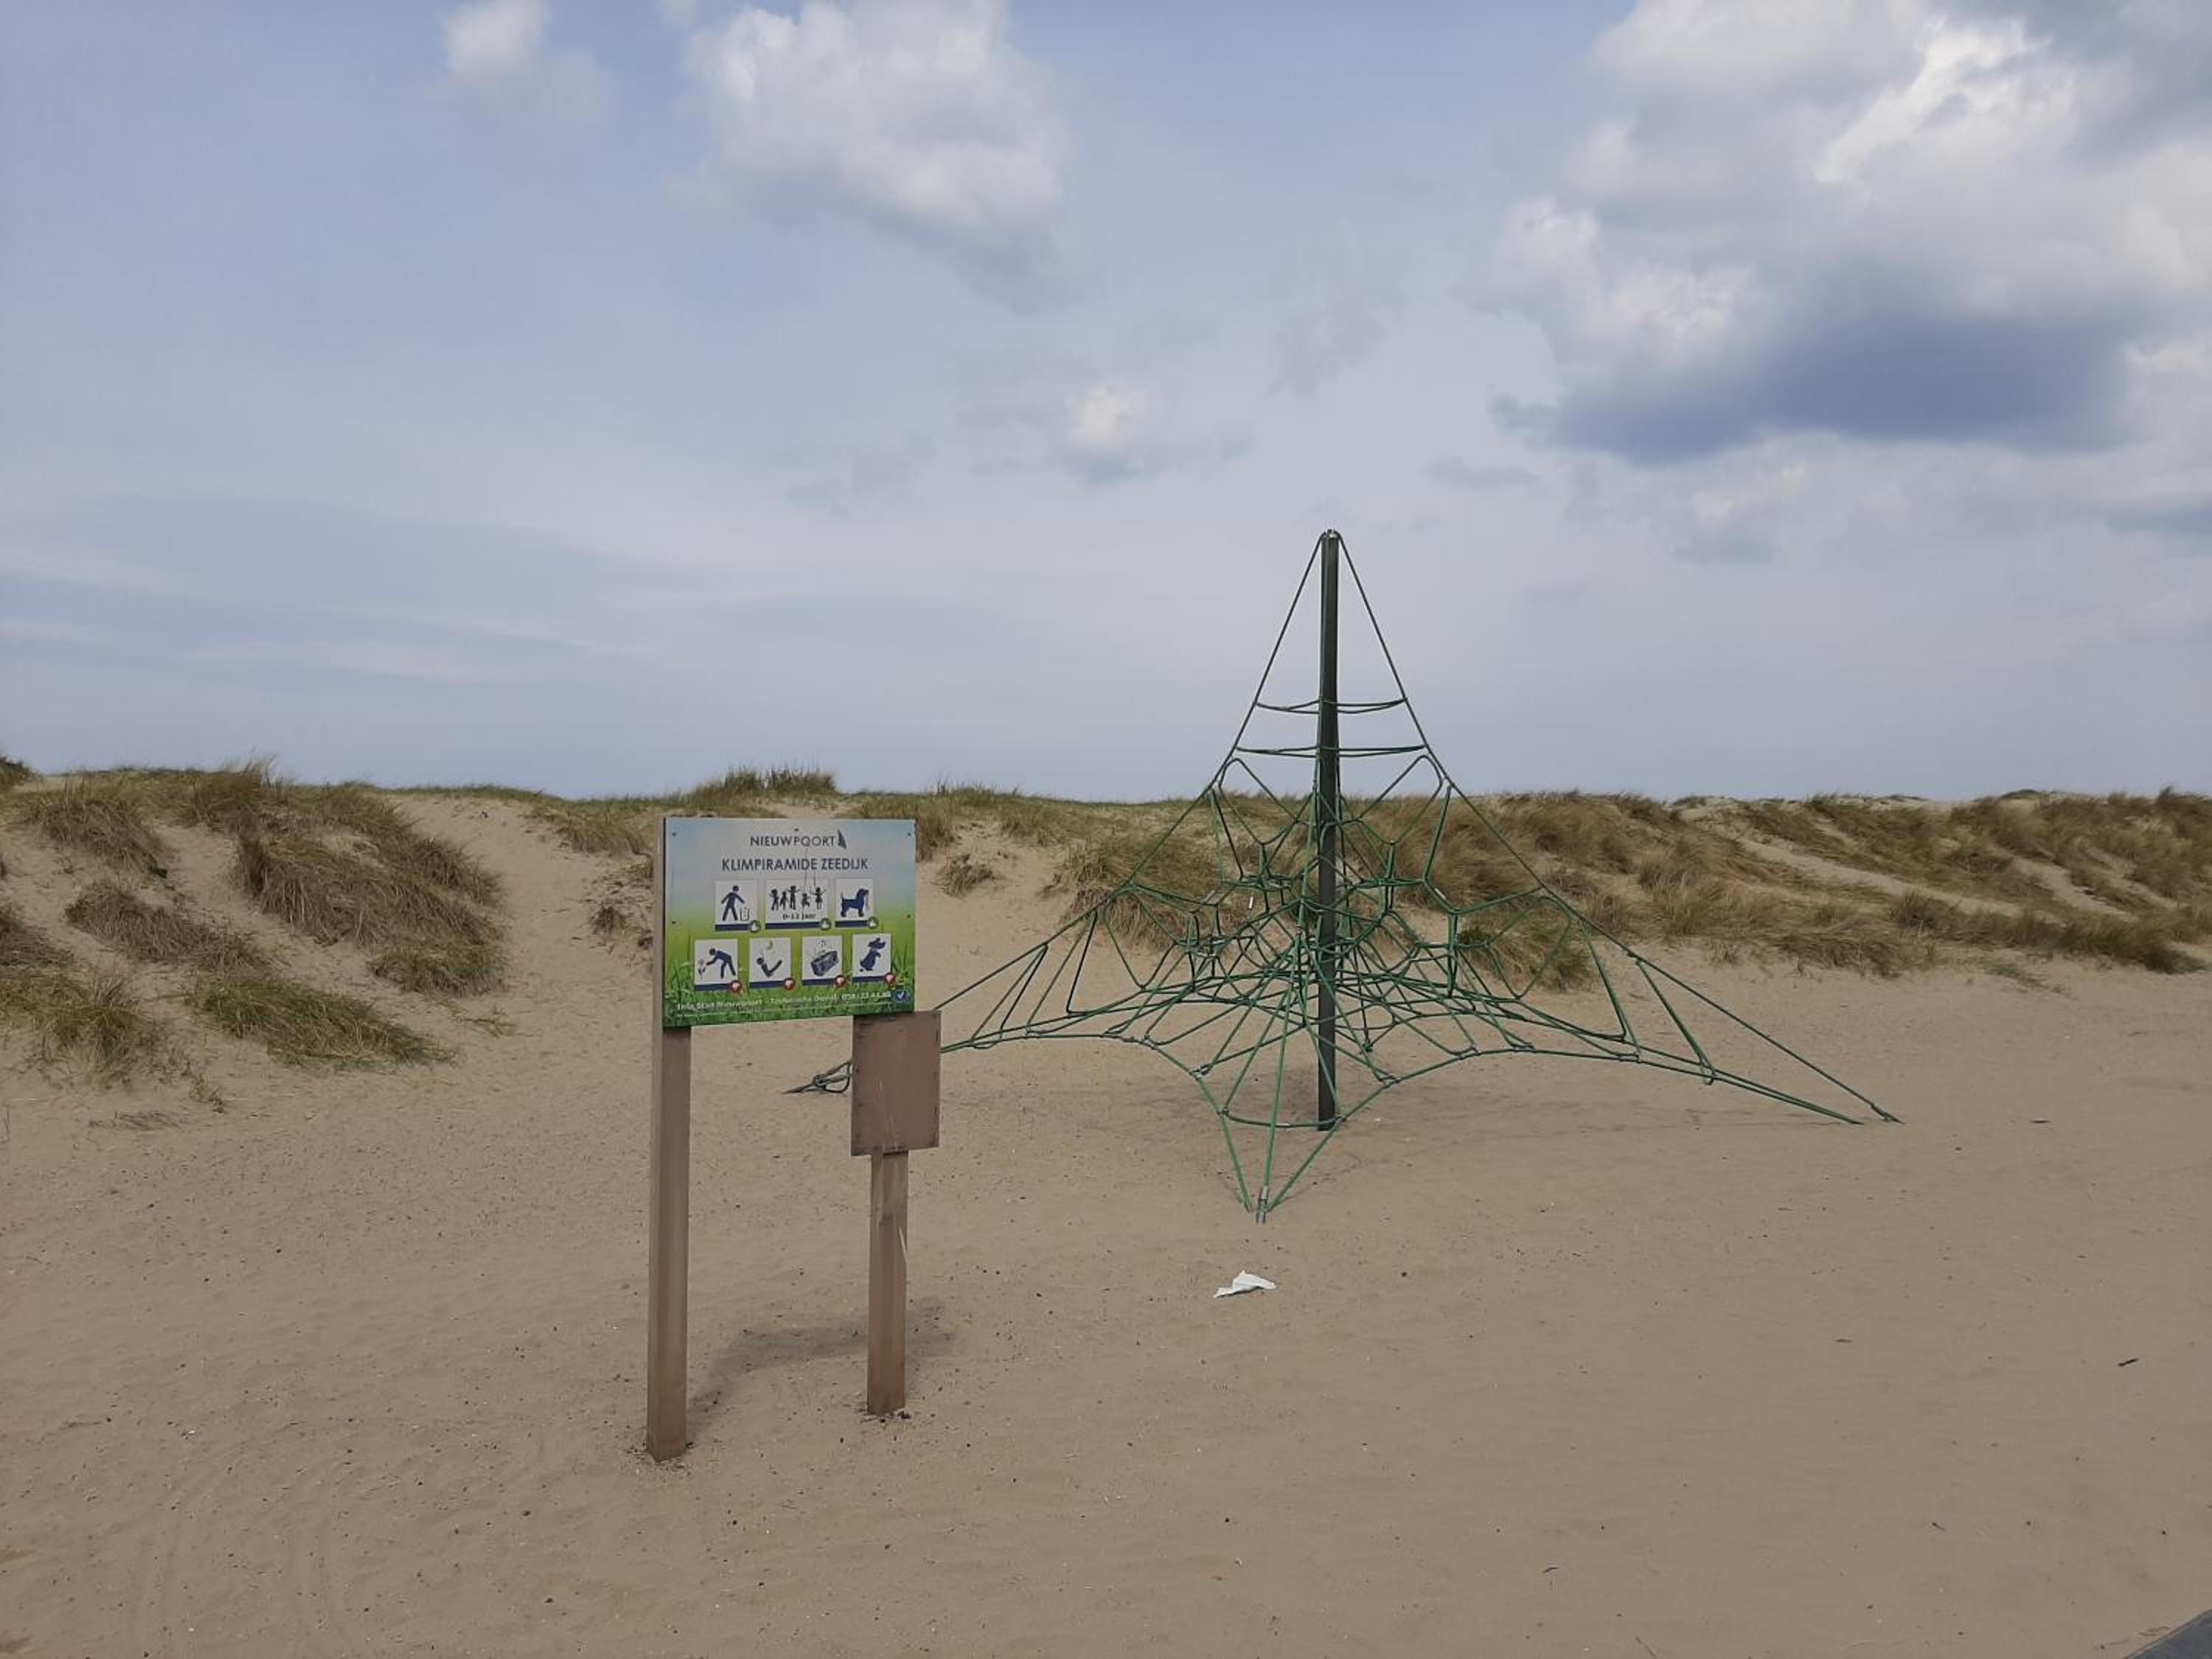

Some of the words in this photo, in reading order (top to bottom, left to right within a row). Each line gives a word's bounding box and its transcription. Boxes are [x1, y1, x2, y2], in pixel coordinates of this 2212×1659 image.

[750, 835, 835, 846] NIEUWPOORT
[722, 858, 818, 871] KLIMPIRAMIDE
[821, 858, 869, 870] ZEEDIJK
